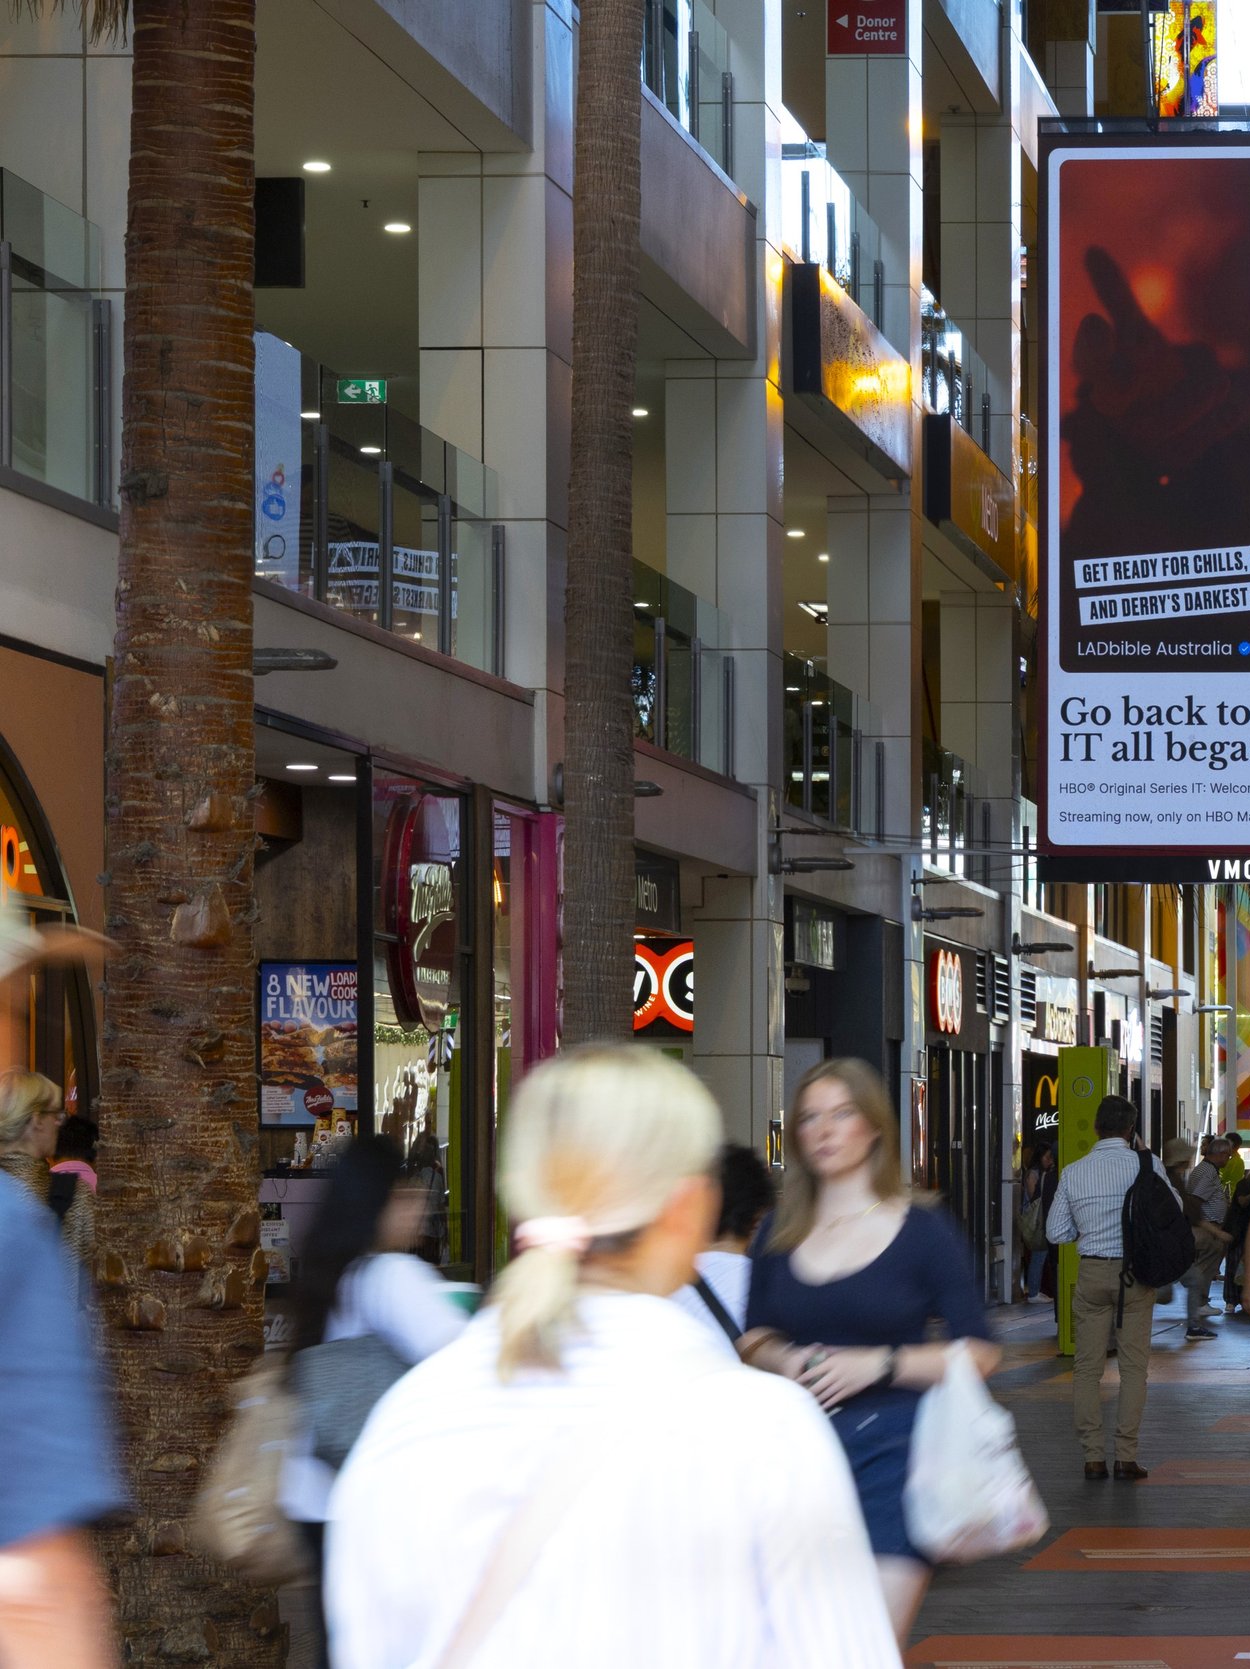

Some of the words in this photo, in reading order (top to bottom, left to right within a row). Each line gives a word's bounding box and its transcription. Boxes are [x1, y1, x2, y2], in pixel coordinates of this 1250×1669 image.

[856, 15, 897, 28] Donor
[855, 28, 898, 41] Centre
[1082, 562, 1109, 584] GET
[1113, 557, 1158, 581] READY
[1162, 555, 1190, 577] FOR
[1193, 550, 1248, 575] CHILLS,
[1090, 599, 1118, 621] AND
[1121, 594, 1180, 617] DERRY'S
[1184, 587, 1248, 612] DARKEST
[1077, 640, 1152, 657] LADbible
[1155, 640, 1233, 657] Australia
[1059, 696, 1112, 726] Go
[1121, 695, 1207, 726] back
[1059, 732, 1102, 762] IT
[1111, 731, 1155, 762] all
[1099, 782, 1146, 797] Original
[1149, 782, 1188, 795] Series
[1190, 782, 1207, 795] IT:
[1059, 811, 1122, 825] Streaming
[1124, 813, 1153, 825] now,
[1157, 811, 1182, 825] only
[1186, 813, 1202, 823] on
[1205, 811, 1234, 823] HBO
[637, 874, 659, 914] Metro
[266, 973, 281, 996] 8
[286, 974, 330, 996] NEW
[635, 995, 656, 1017] WINE
